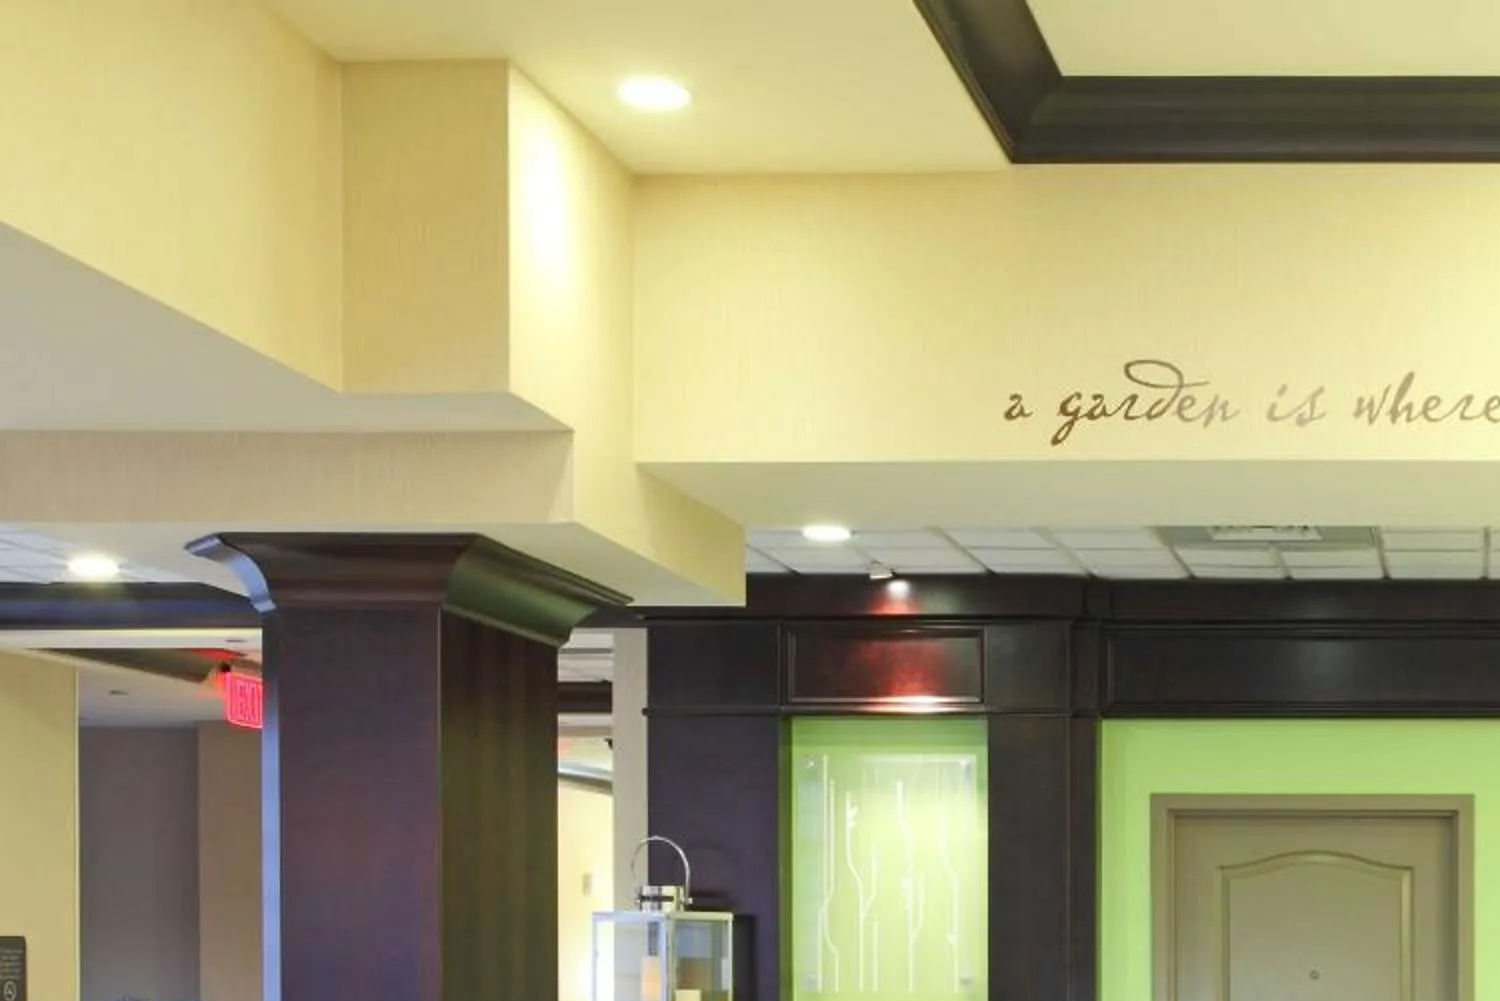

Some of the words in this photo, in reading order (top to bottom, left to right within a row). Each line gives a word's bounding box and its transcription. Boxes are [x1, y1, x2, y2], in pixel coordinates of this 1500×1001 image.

[1002, 391, 1035, 423] a
[1049, 358, 1241, 448] garden
[1264, 383, 1329, 429] is
